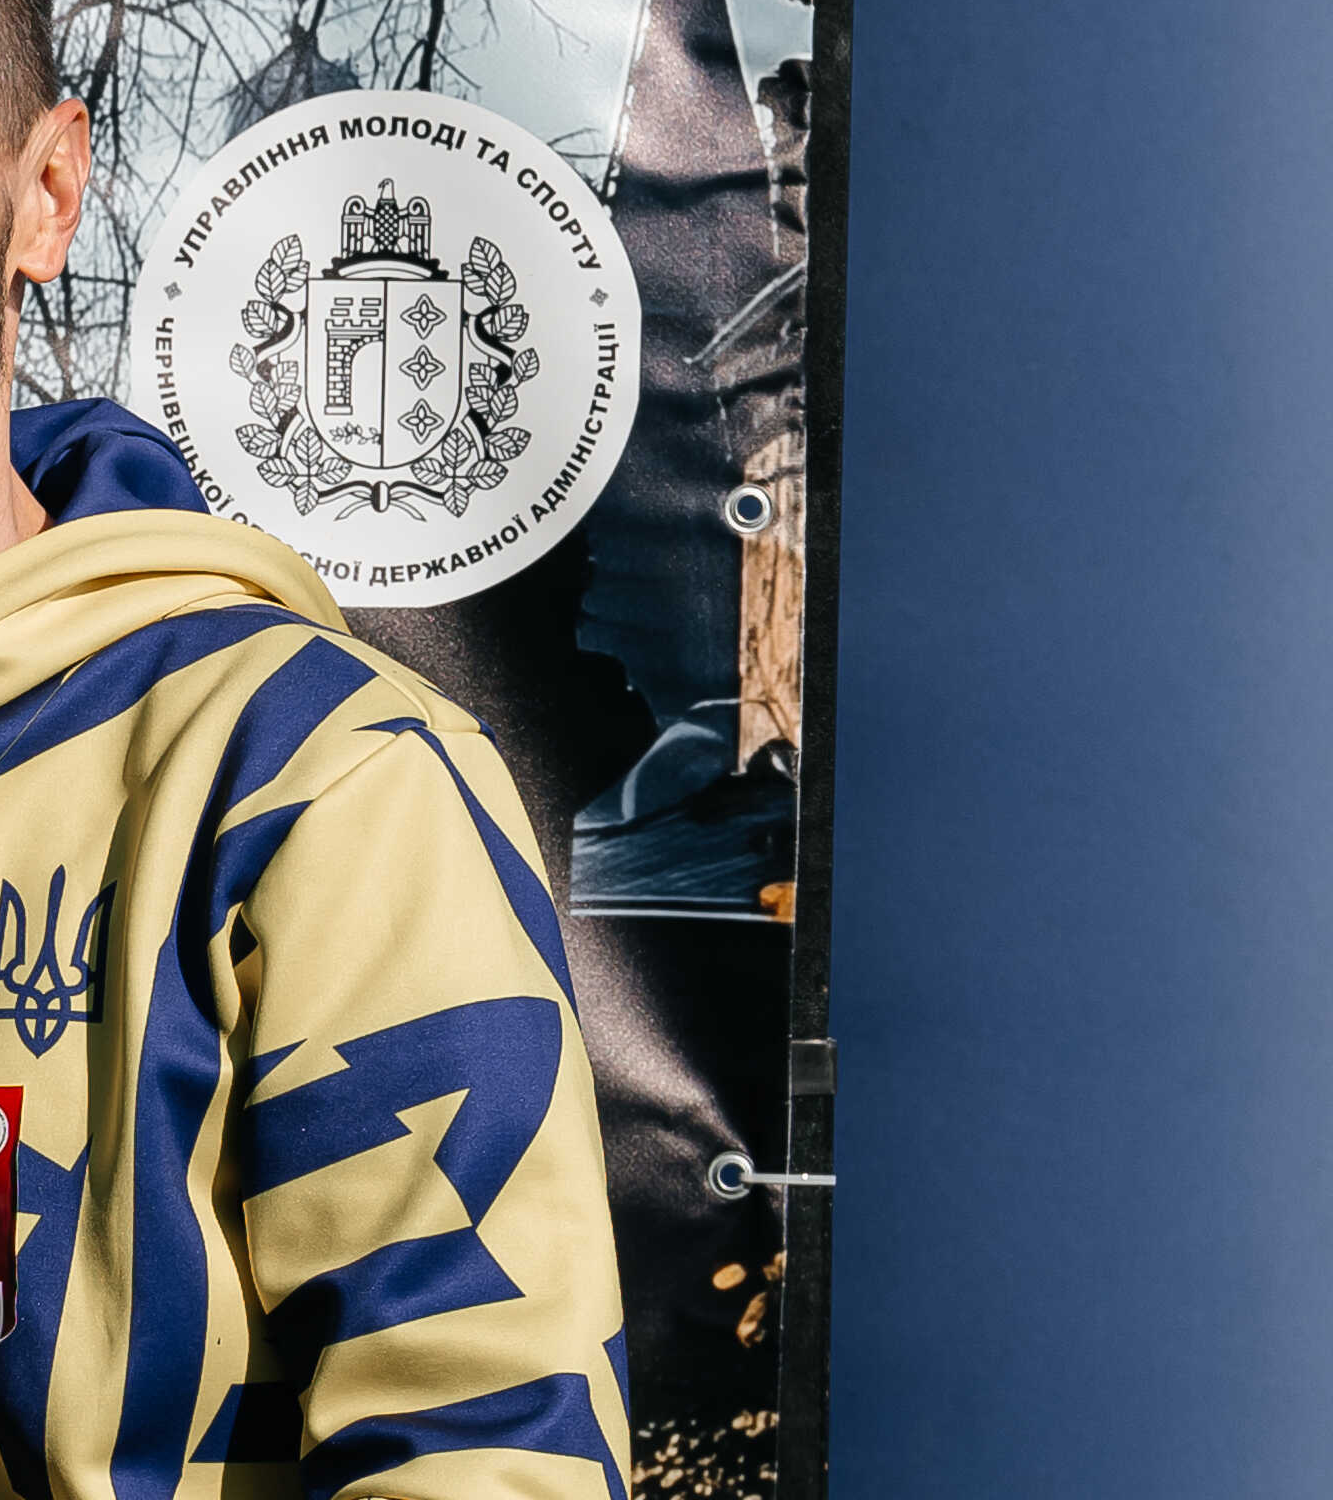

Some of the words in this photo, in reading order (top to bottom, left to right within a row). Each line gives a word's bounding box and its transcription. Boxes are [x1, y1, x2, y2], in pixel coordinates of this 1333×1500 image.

[174, 124, 330, 269] УПРАВЛІННЯ
[339, 114, 467, 151] МОЛОДІ
[475, 137, 510, 173] ТА
[516, 167, 603, 274] СПОРТУ
[368, 512, 530, 587] ДЕРЖАВНОЇ
[529, 320, 621, 525] АДМІНІСТРАЦІЇ
